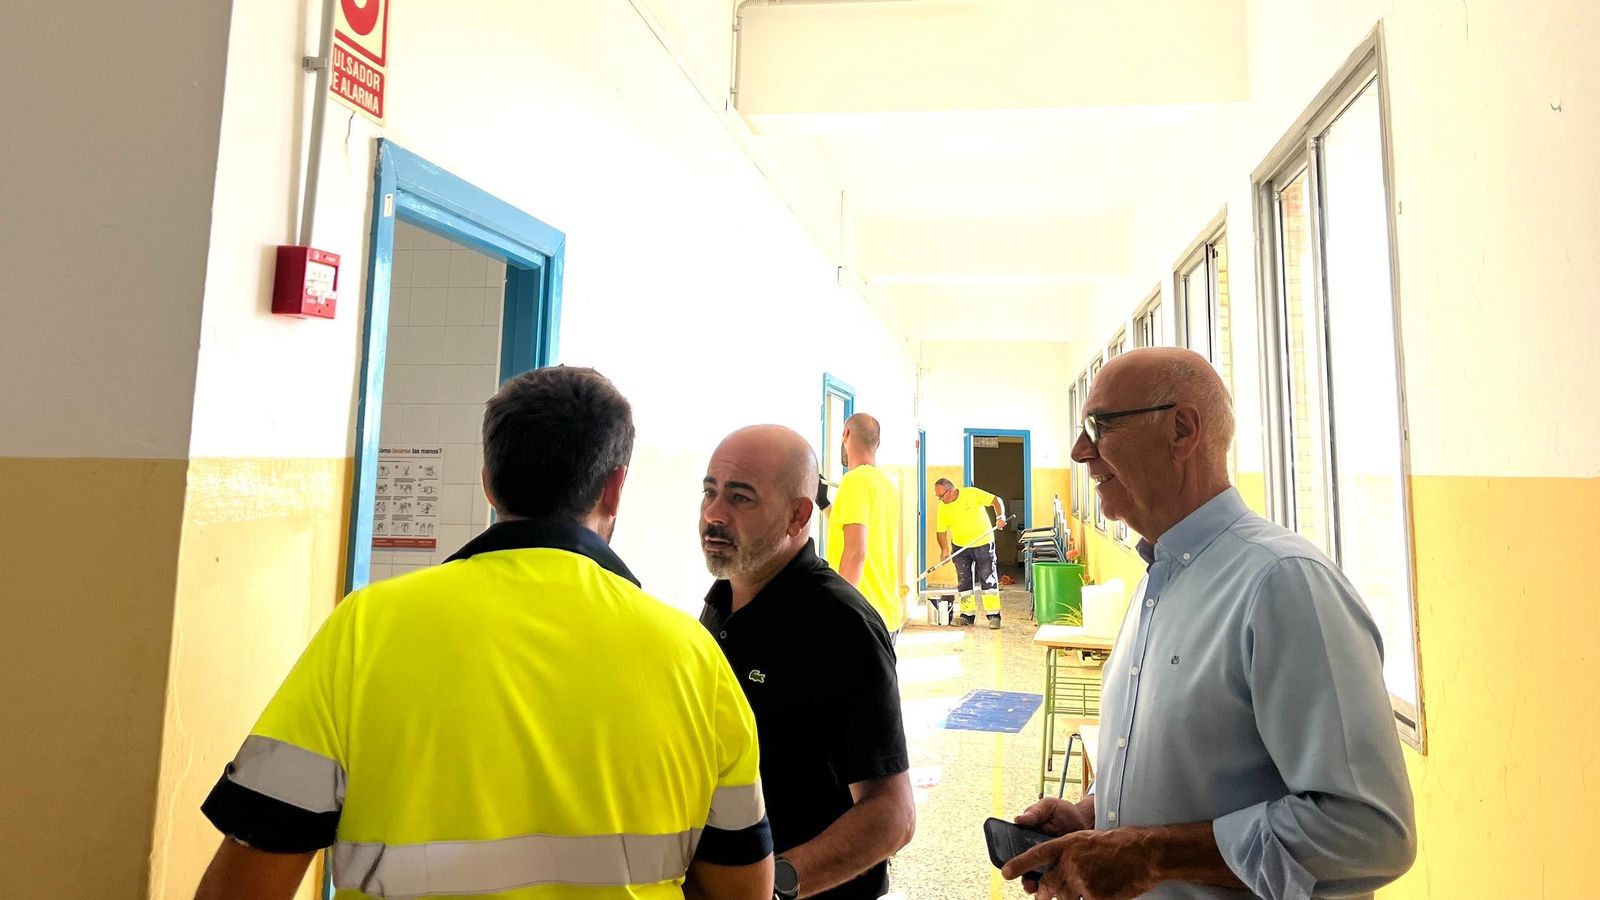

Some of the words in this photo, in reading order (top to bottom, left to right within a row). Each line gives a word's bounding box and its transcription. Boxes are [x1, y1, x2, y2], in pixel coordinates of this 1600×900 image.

[333, 48, 380, 92] ULSADOR
[332, 72, 339, 90] E
[340, 77, 380, 115] ALARMA
[412, 447, 420, 455] las
[421, 447, 442, 455] manos?
